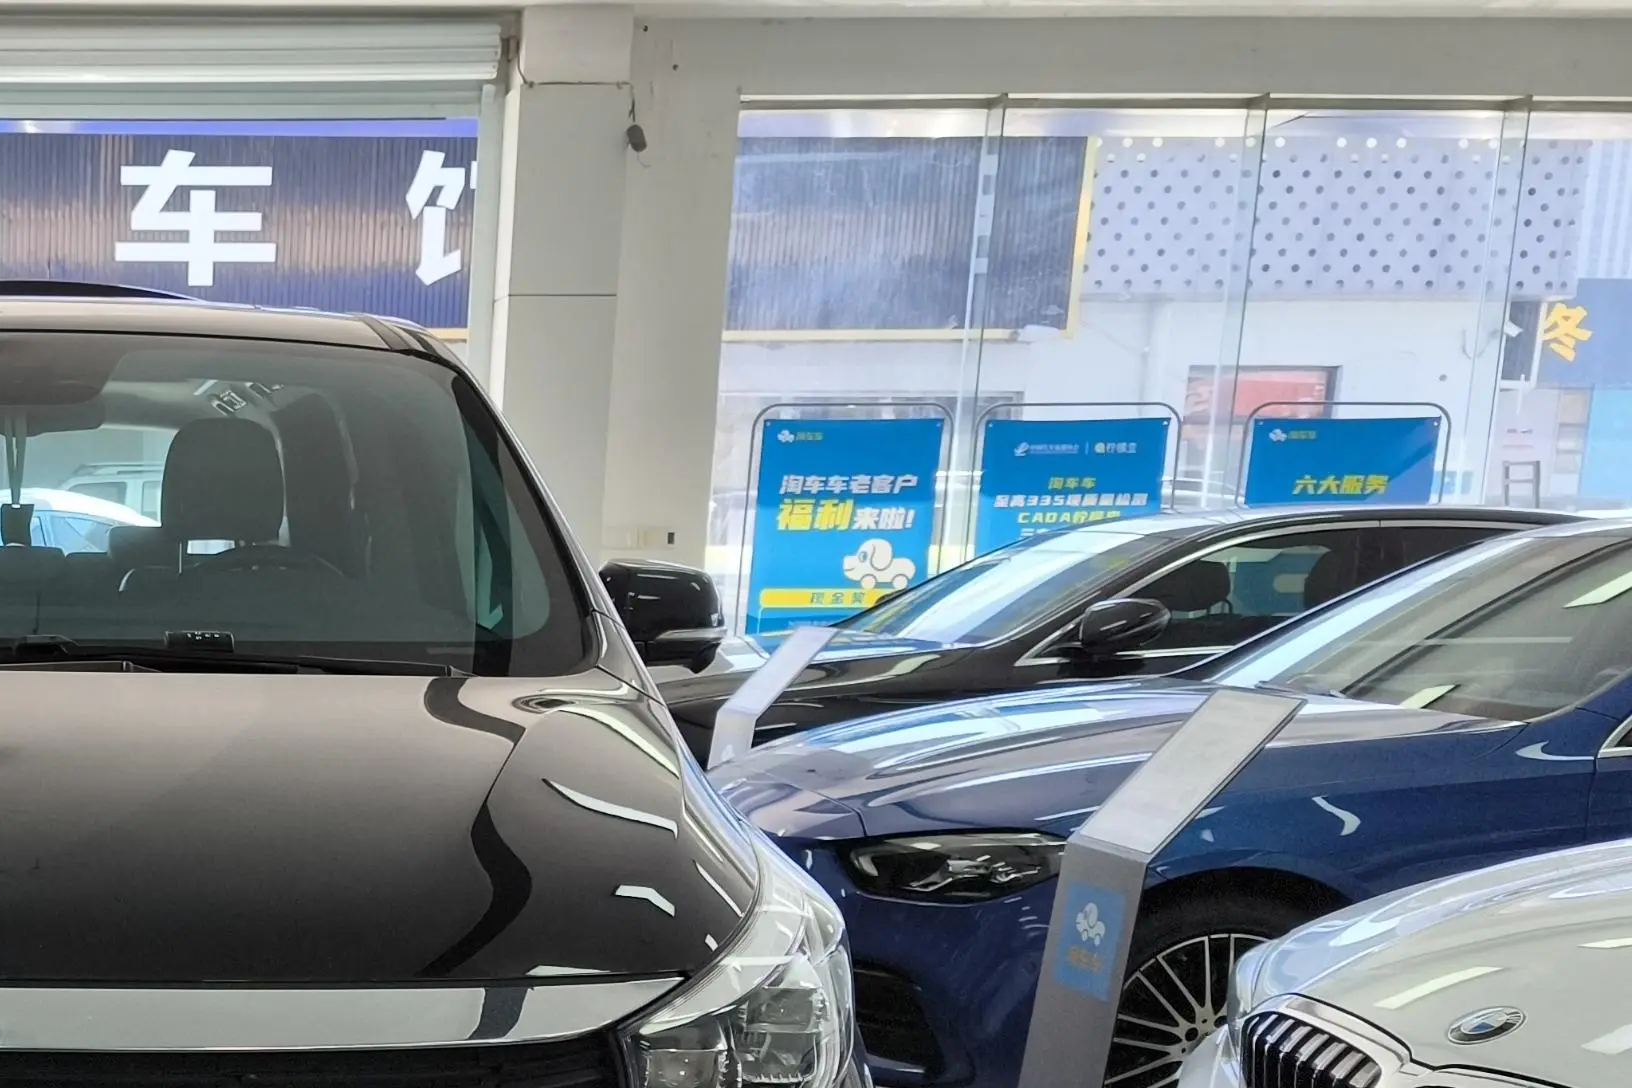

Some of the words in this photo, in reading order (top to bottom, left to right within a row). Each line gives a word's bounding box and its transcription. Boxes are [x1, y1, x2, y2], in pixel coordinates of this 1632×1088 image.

[779, 474, 918, 494] 淘车车老客户
[1292, 474, 1389, 496] 六大服务
